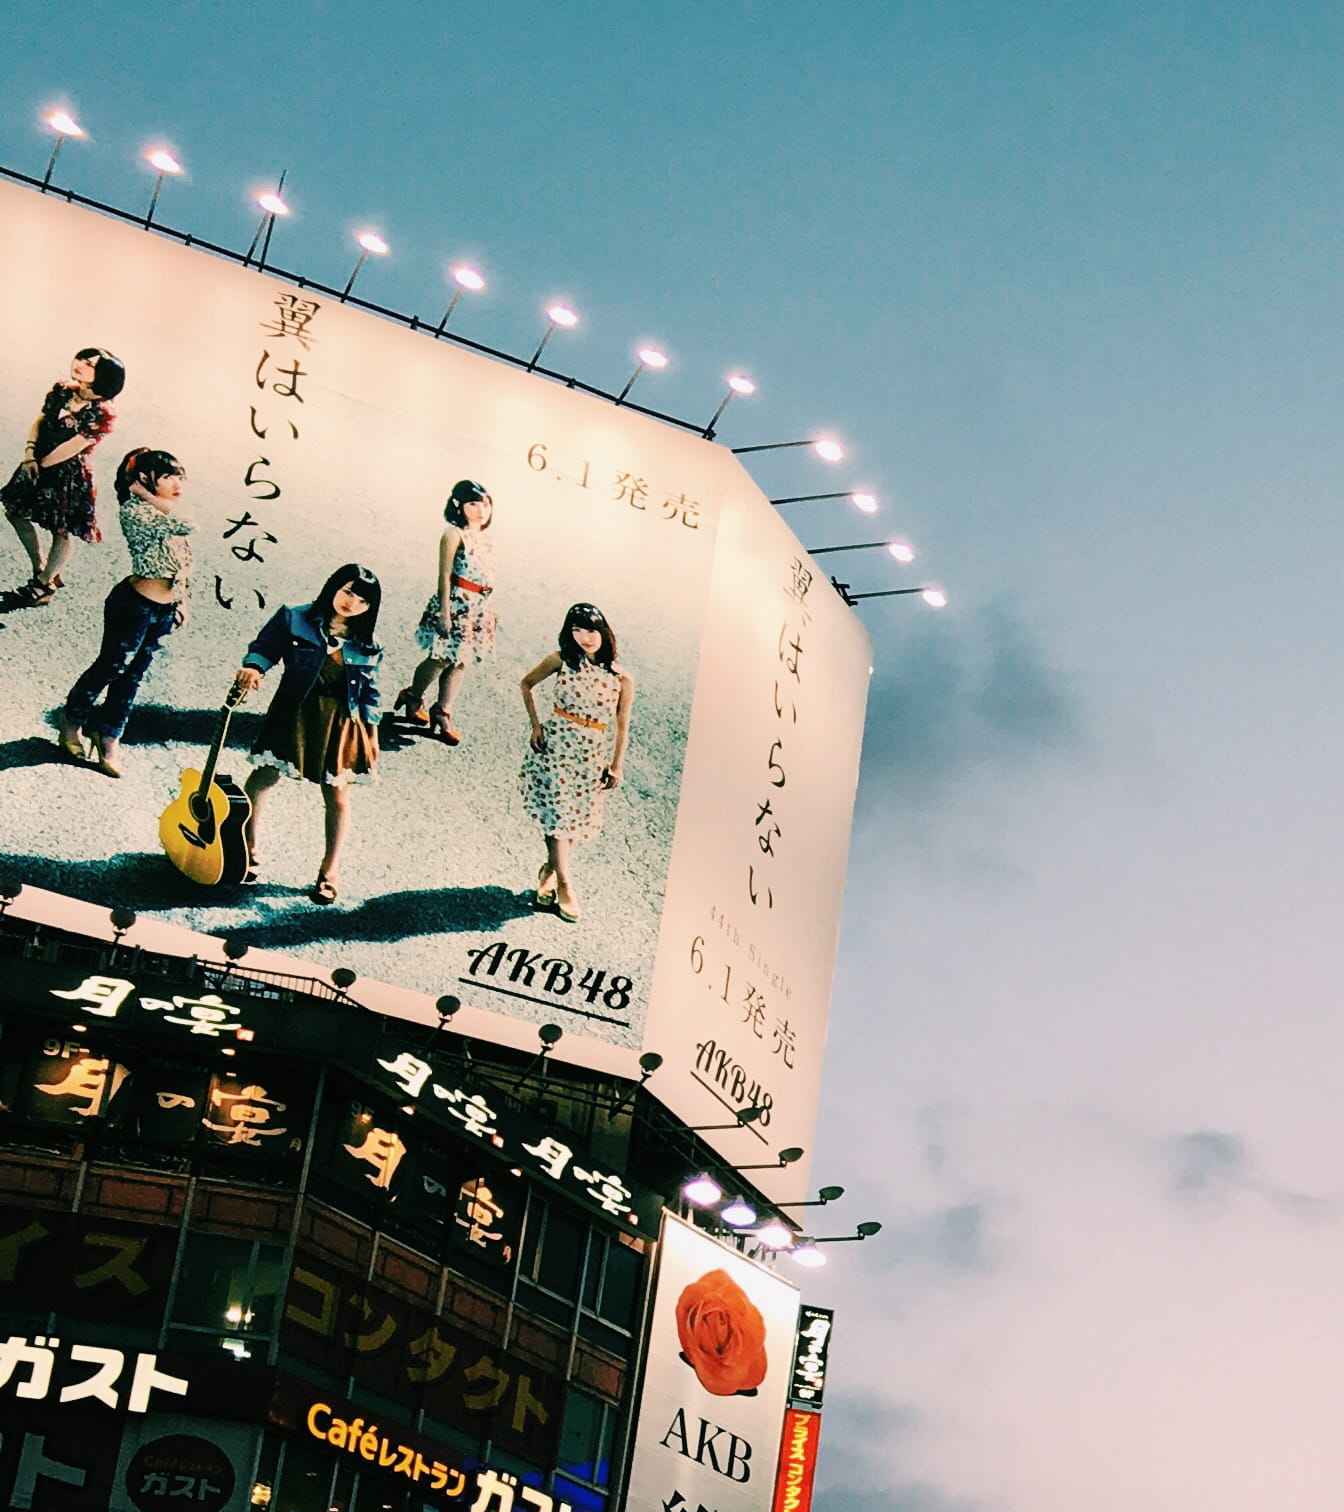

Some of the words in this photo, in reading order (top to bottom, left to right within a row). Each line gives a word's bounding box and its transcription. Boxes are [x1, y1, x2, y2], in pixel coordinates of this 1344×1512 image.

[213, 291, 325, 612] 翼はいらない
[749, 556, 813, 909] 翼はいらない
[50, 975, 242, 1036] 月の宴
[467, 941, 635, 1012] AKB48
[376, 1052, 497, 1137] 月の宴
[695, 1039, 774, 1127] AKB48
[521, 1137, 632, 1215] 月の宴
[0, 1333, 190, 1414] ガスト
[285, 1265, 550, 1434] コンタクト
[140, 1472, 221, 1500] ガスト
[658, 1407, 752, 1484] AKB
